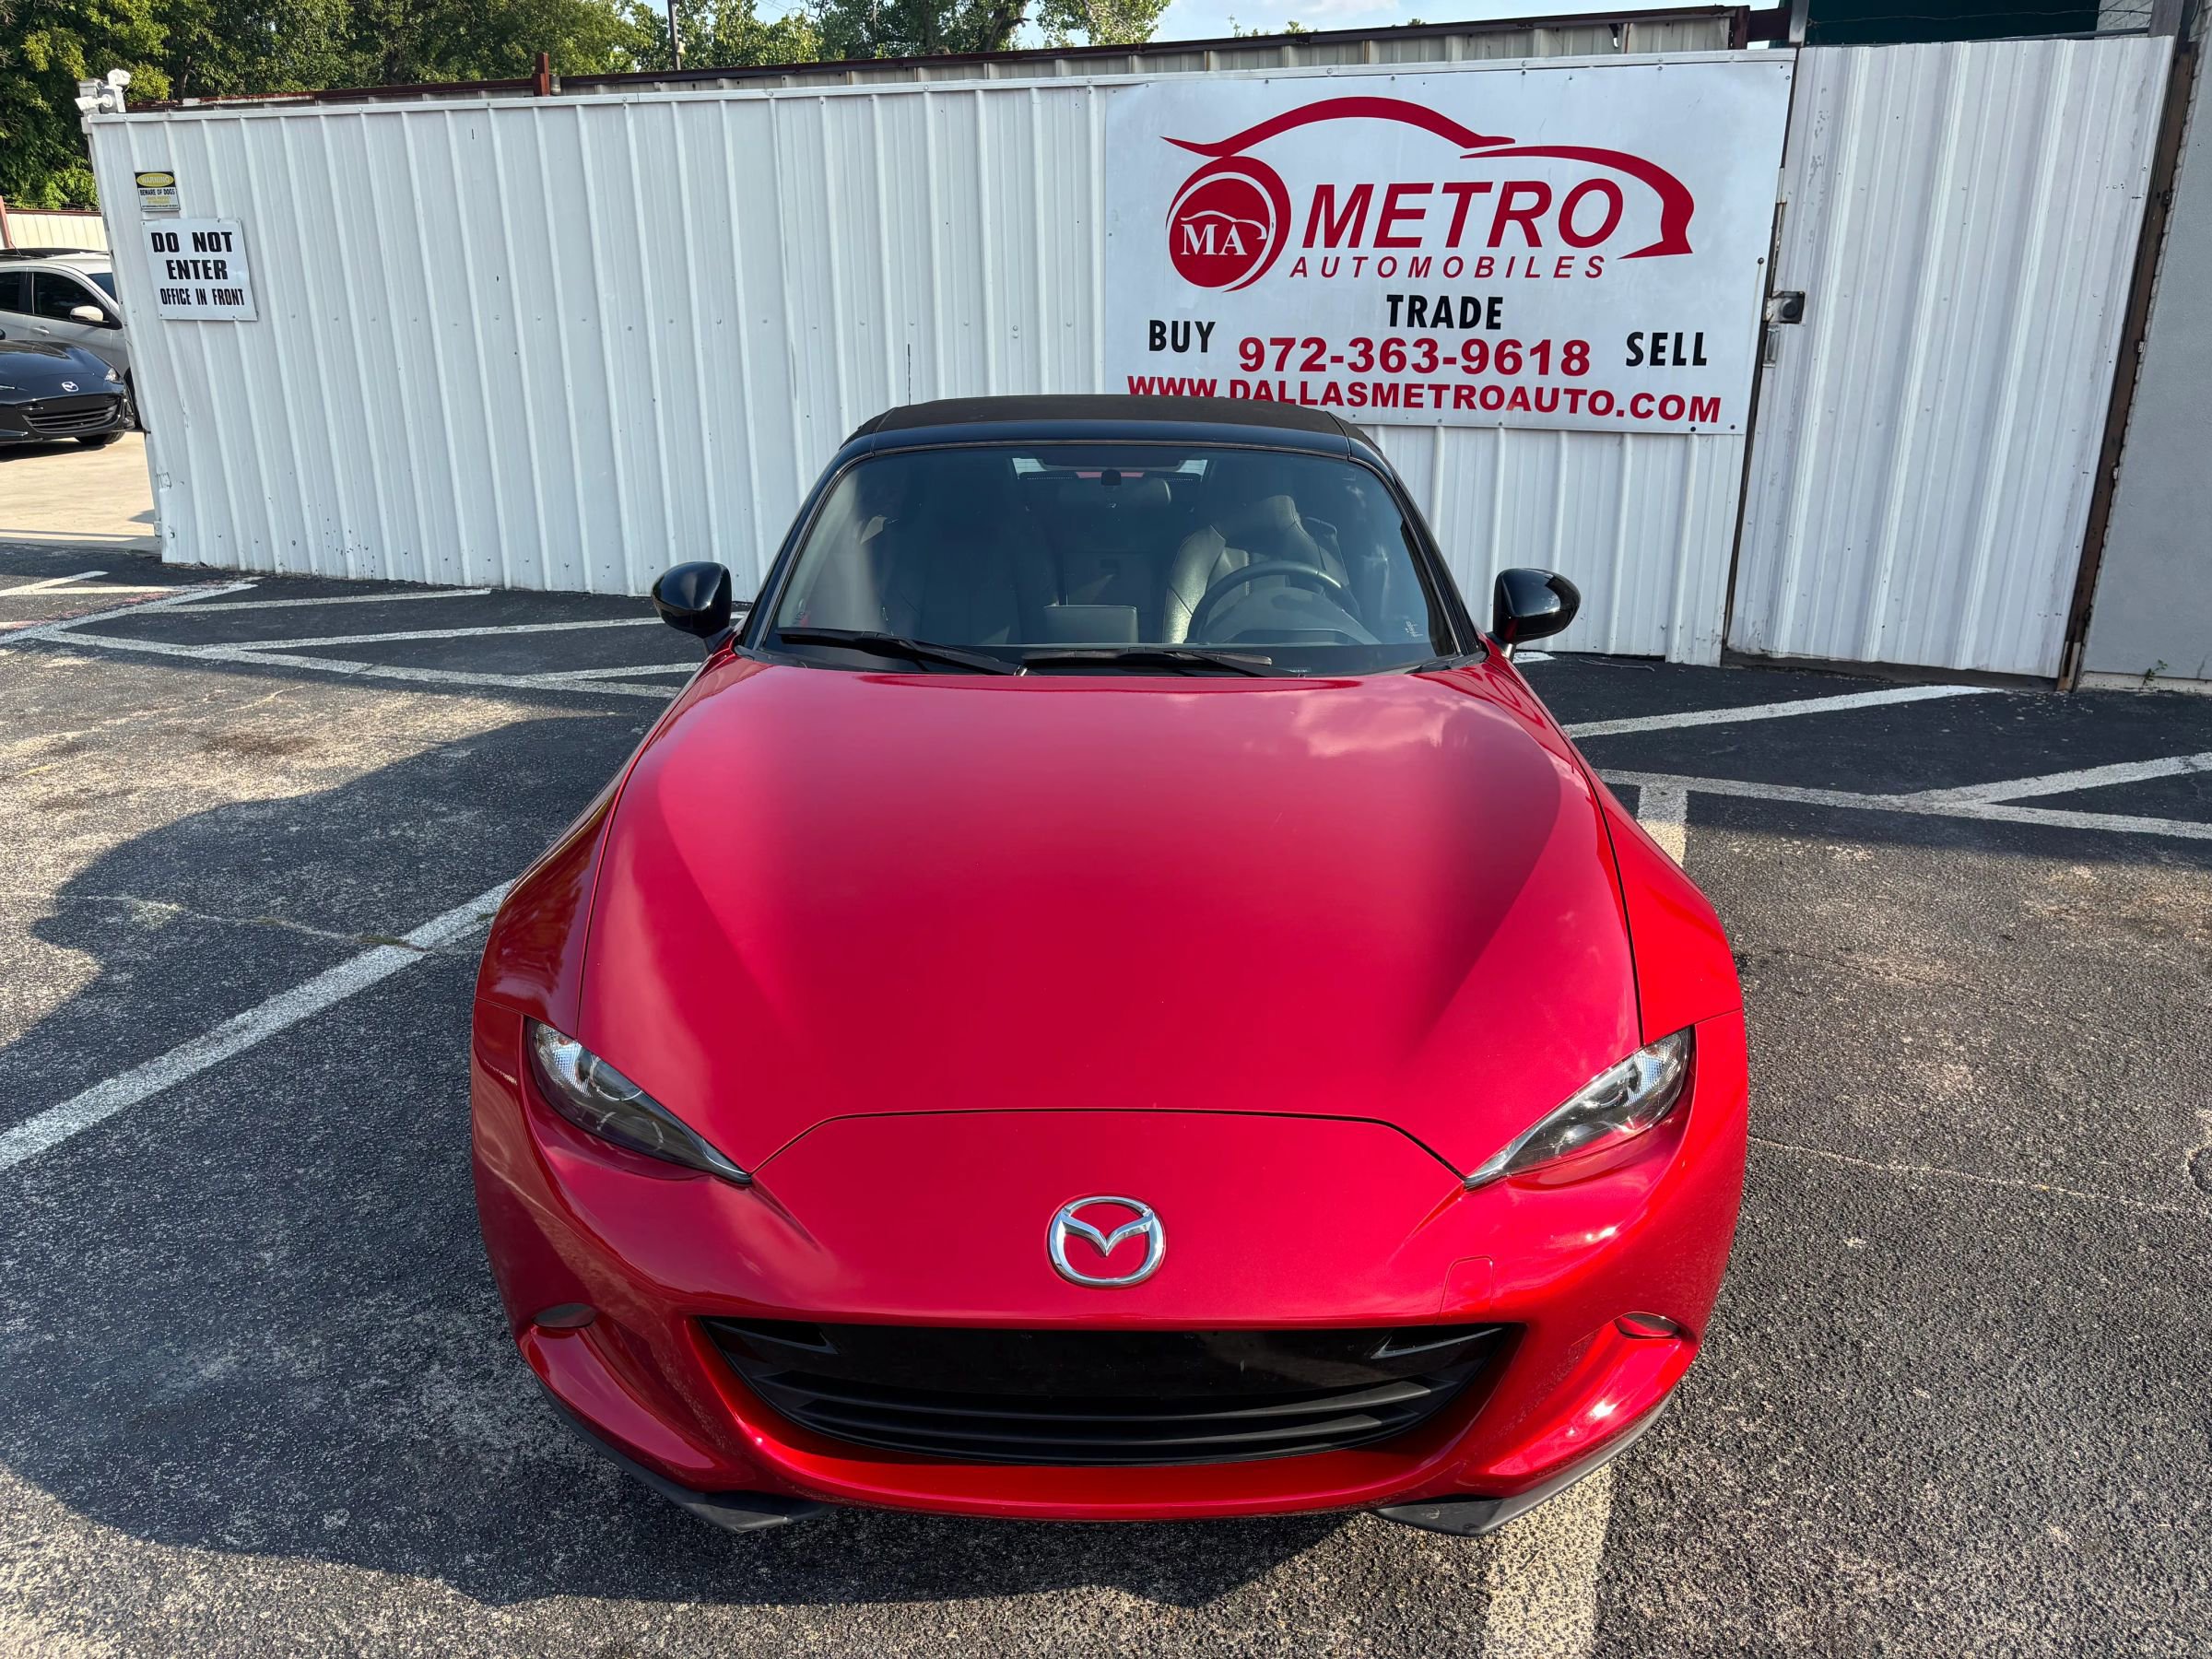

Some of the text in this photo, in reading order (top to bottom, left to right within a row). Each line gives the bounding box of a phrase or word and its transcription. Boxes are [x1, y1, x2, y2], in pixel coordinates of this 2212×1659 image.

[140, 176, 171, 184] WARNING
[1302, 178, 1623, 249] METRO
[150, 231, 232, 253] DO NOT
[1181, 223, 1248, 255] MA
[165, 259, 229, 280] ENTER
[1291, 255, 1605, 278] AUTOMOBILES
[159, 288, 245, 306] OFFICE IN FRONT
[1386, 294, 1504, 330] TRADE
[1148, 319, 1216, 354] BUY
[1626, 331, 1708, 367] SELL
[1239, 336, 1590, 376] 972-363-9618
[1127, 375, 1721, 423] WWWDALLASMETROAUTO.COM
